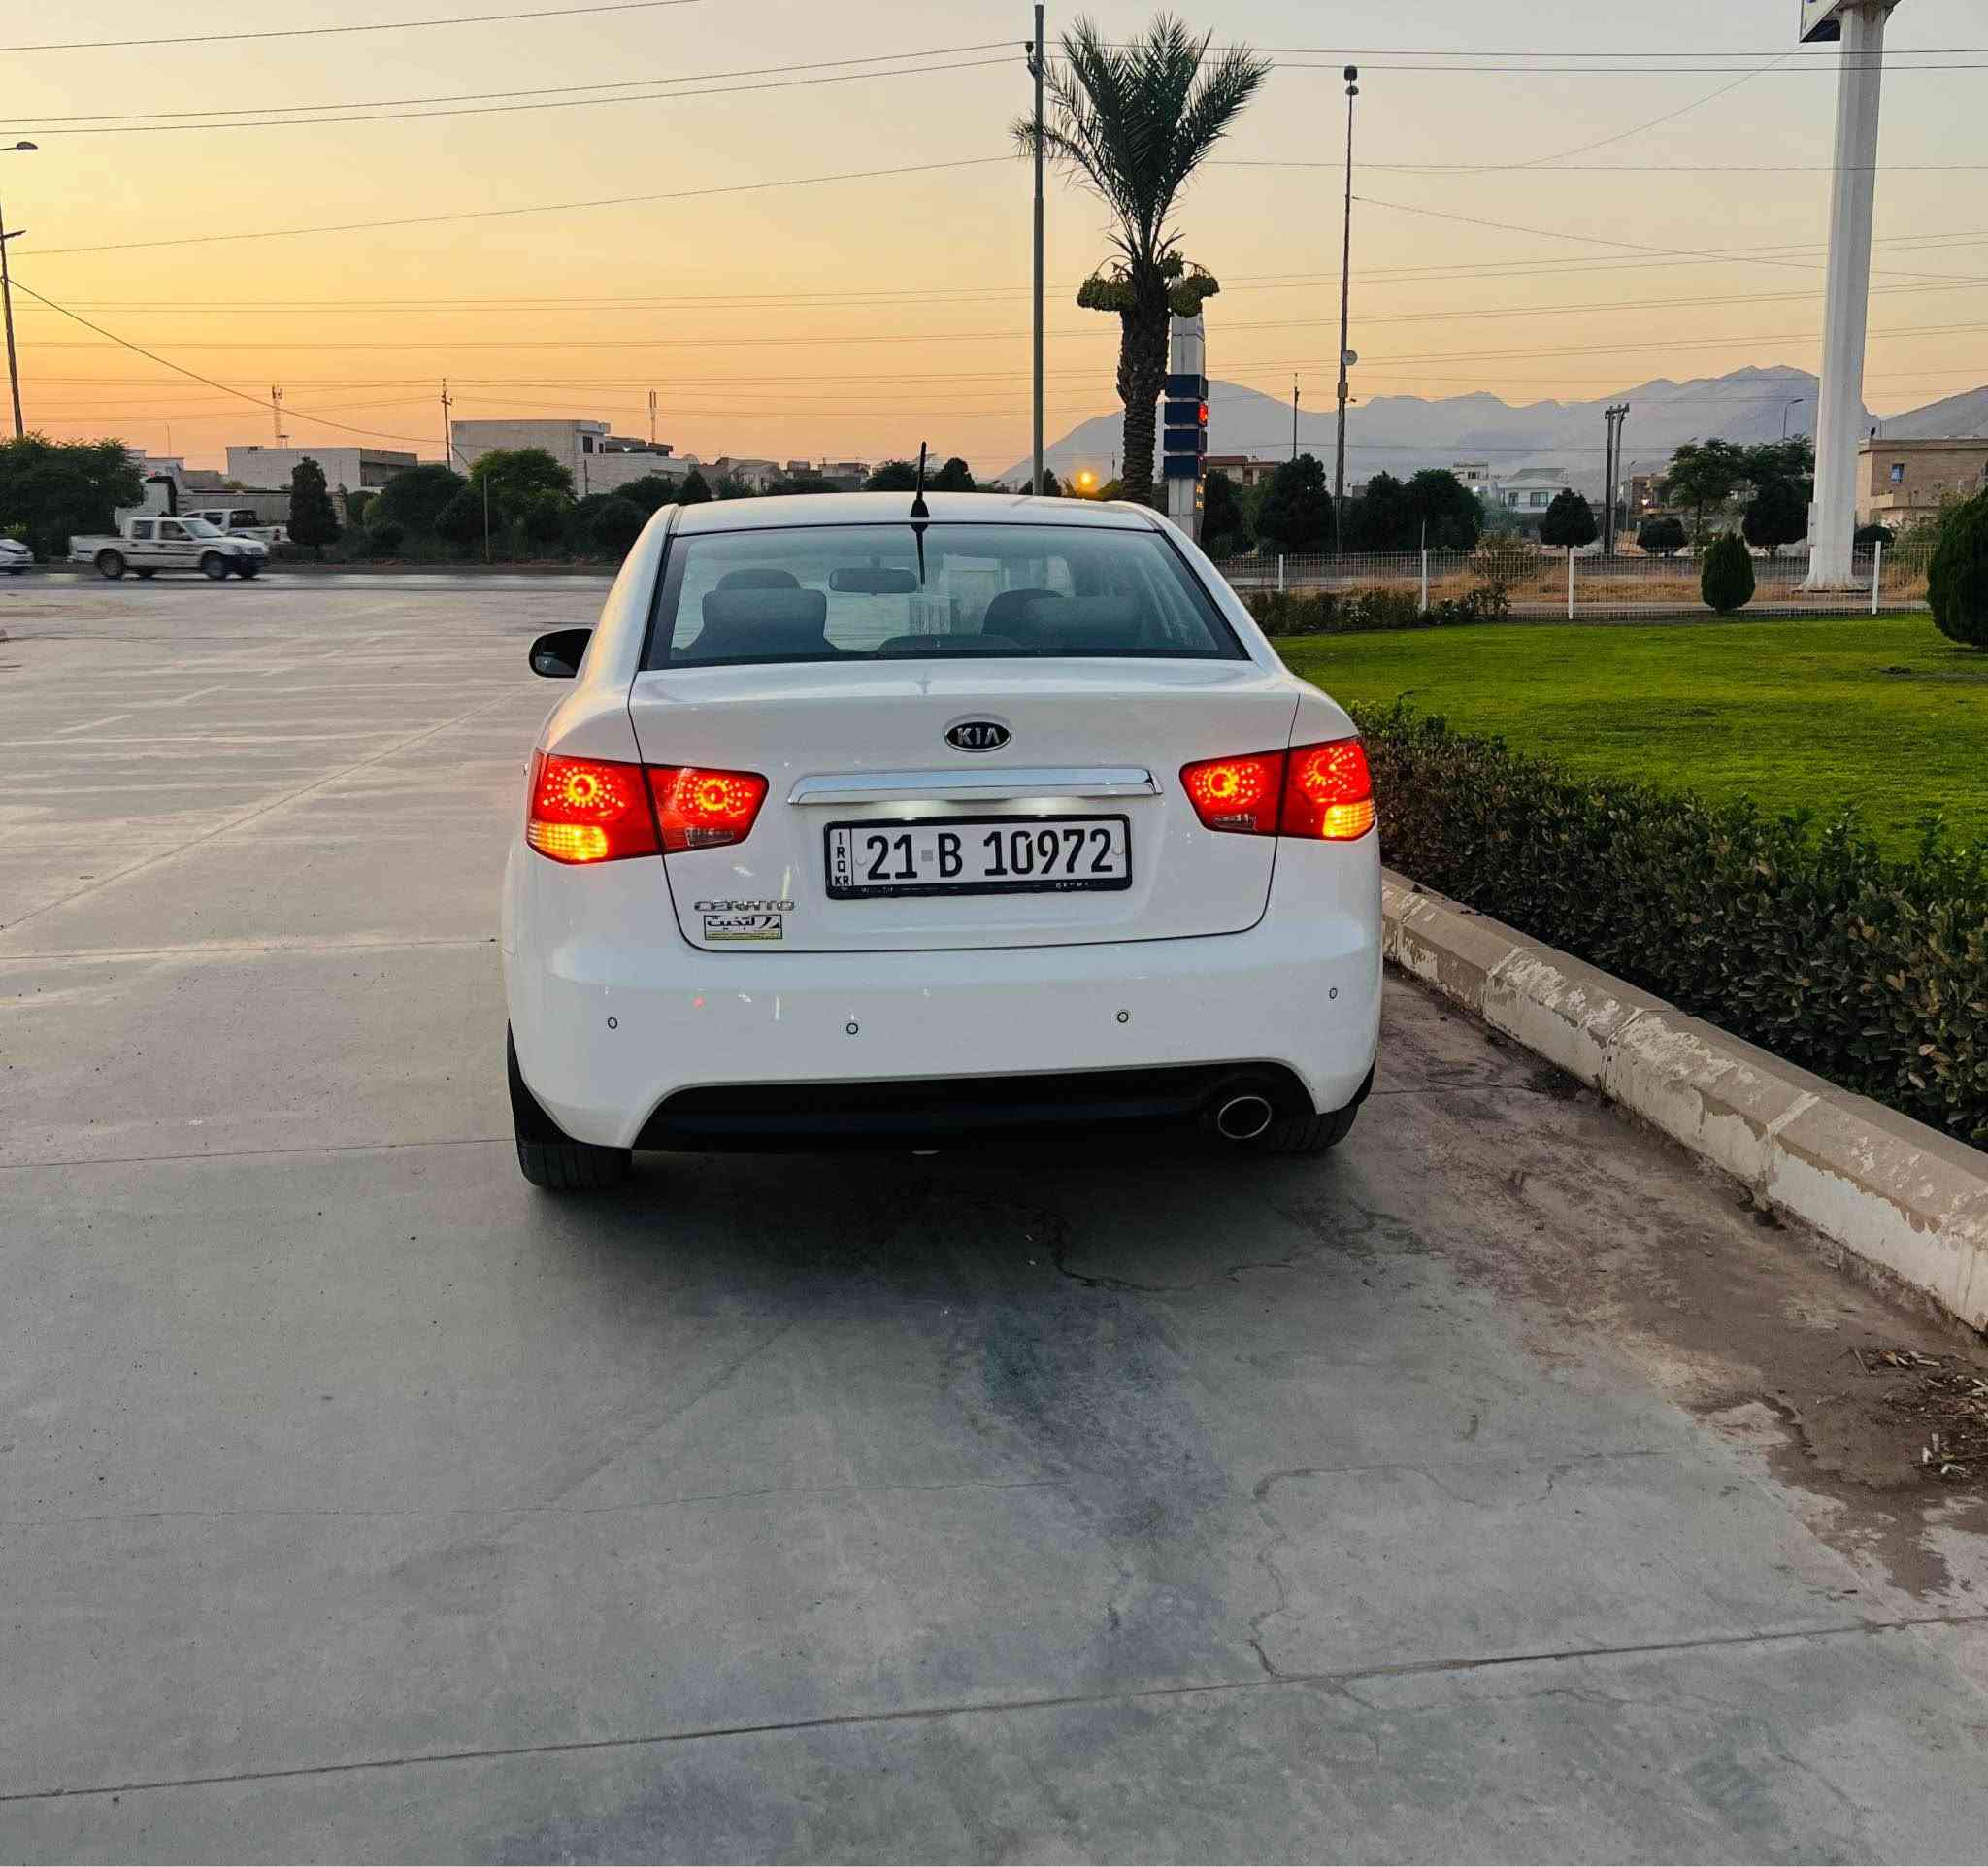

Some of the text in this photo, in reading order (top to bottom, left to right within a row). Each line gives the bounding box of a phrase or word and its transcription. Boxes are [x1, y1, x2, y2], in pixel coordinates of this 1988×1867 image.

[957, 727, 1000, 745] KIA
[866, 828, 1114, 881] 21 B 10972
[834, 875, 850, 886] KR
